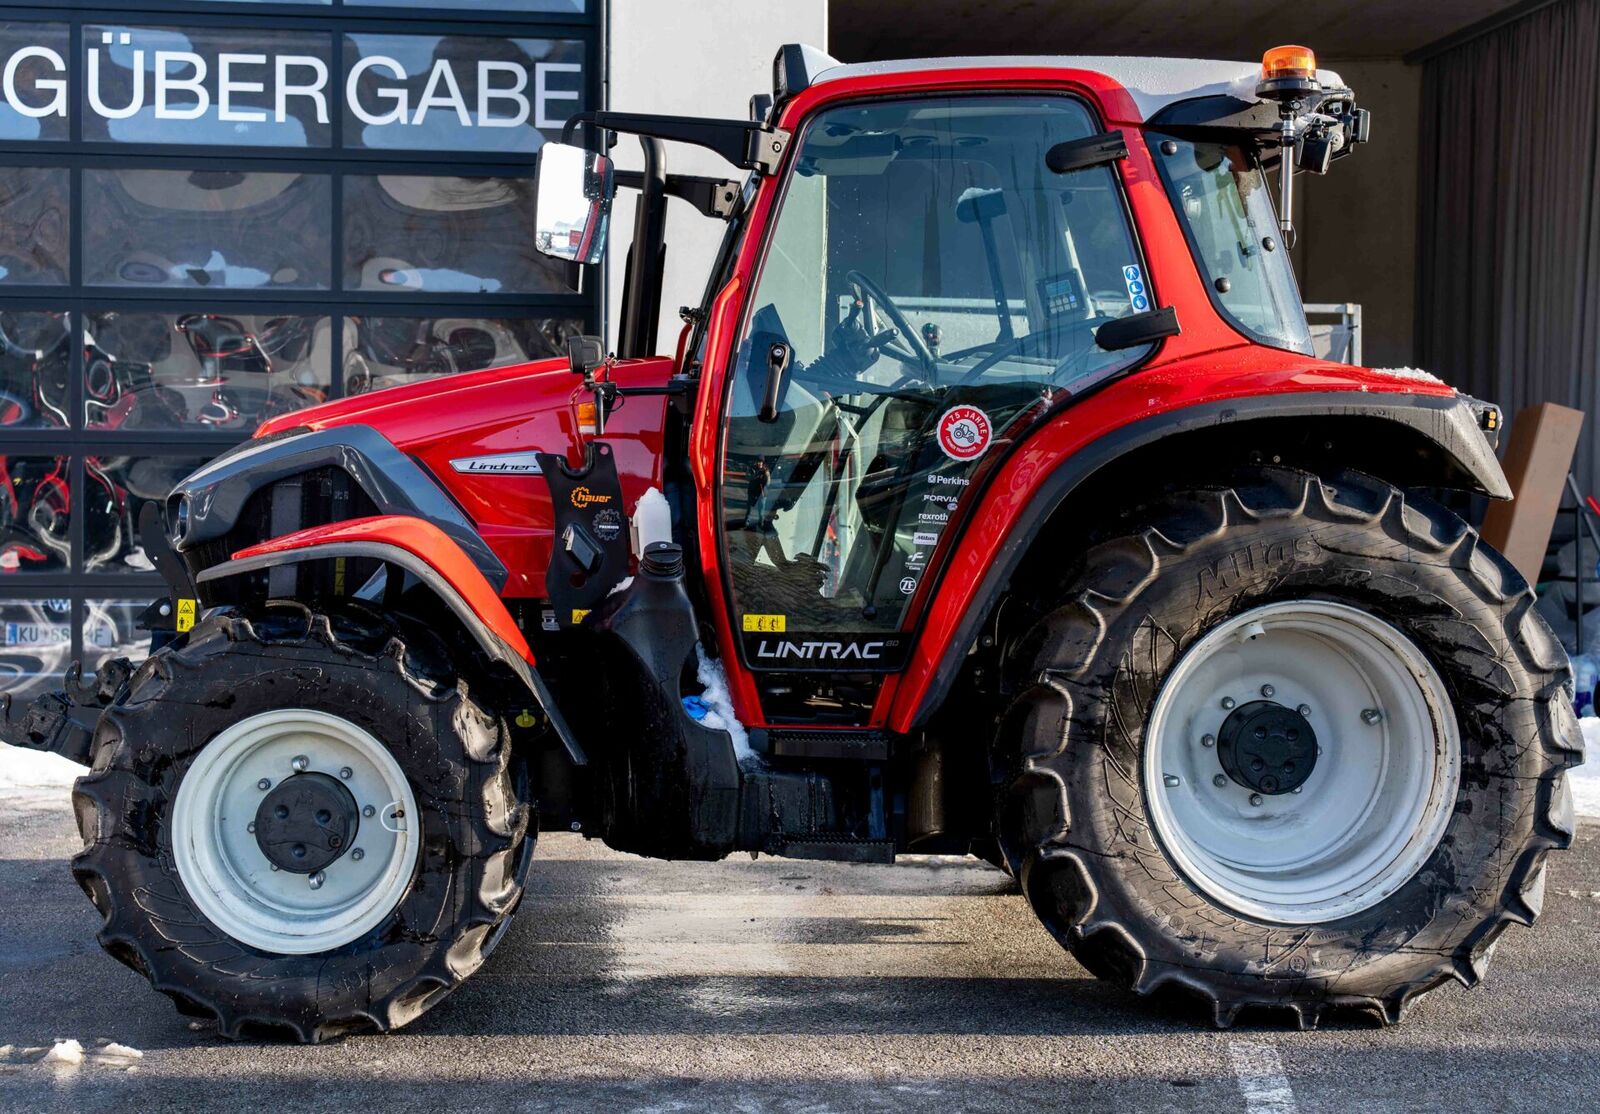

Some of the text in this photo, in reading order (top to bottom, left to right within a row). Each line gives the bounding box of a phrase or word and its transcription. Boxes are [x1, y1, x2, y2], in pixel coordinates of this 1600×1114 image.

[948, 410, 987, 434] 75 JAHRE
[469, 461, 537, 471] Lindner
[936, 475, 970, 486] Perkins
[577, 491, 612, 503] hauer
[923, 494, 958, 503] FORVIA
[918, 513, 949, 521] rexroth
[901, 579, 915, 591] ZF
[19, 627, 38, 641] KU
[757, 641, 884, 659] LINTRAC
